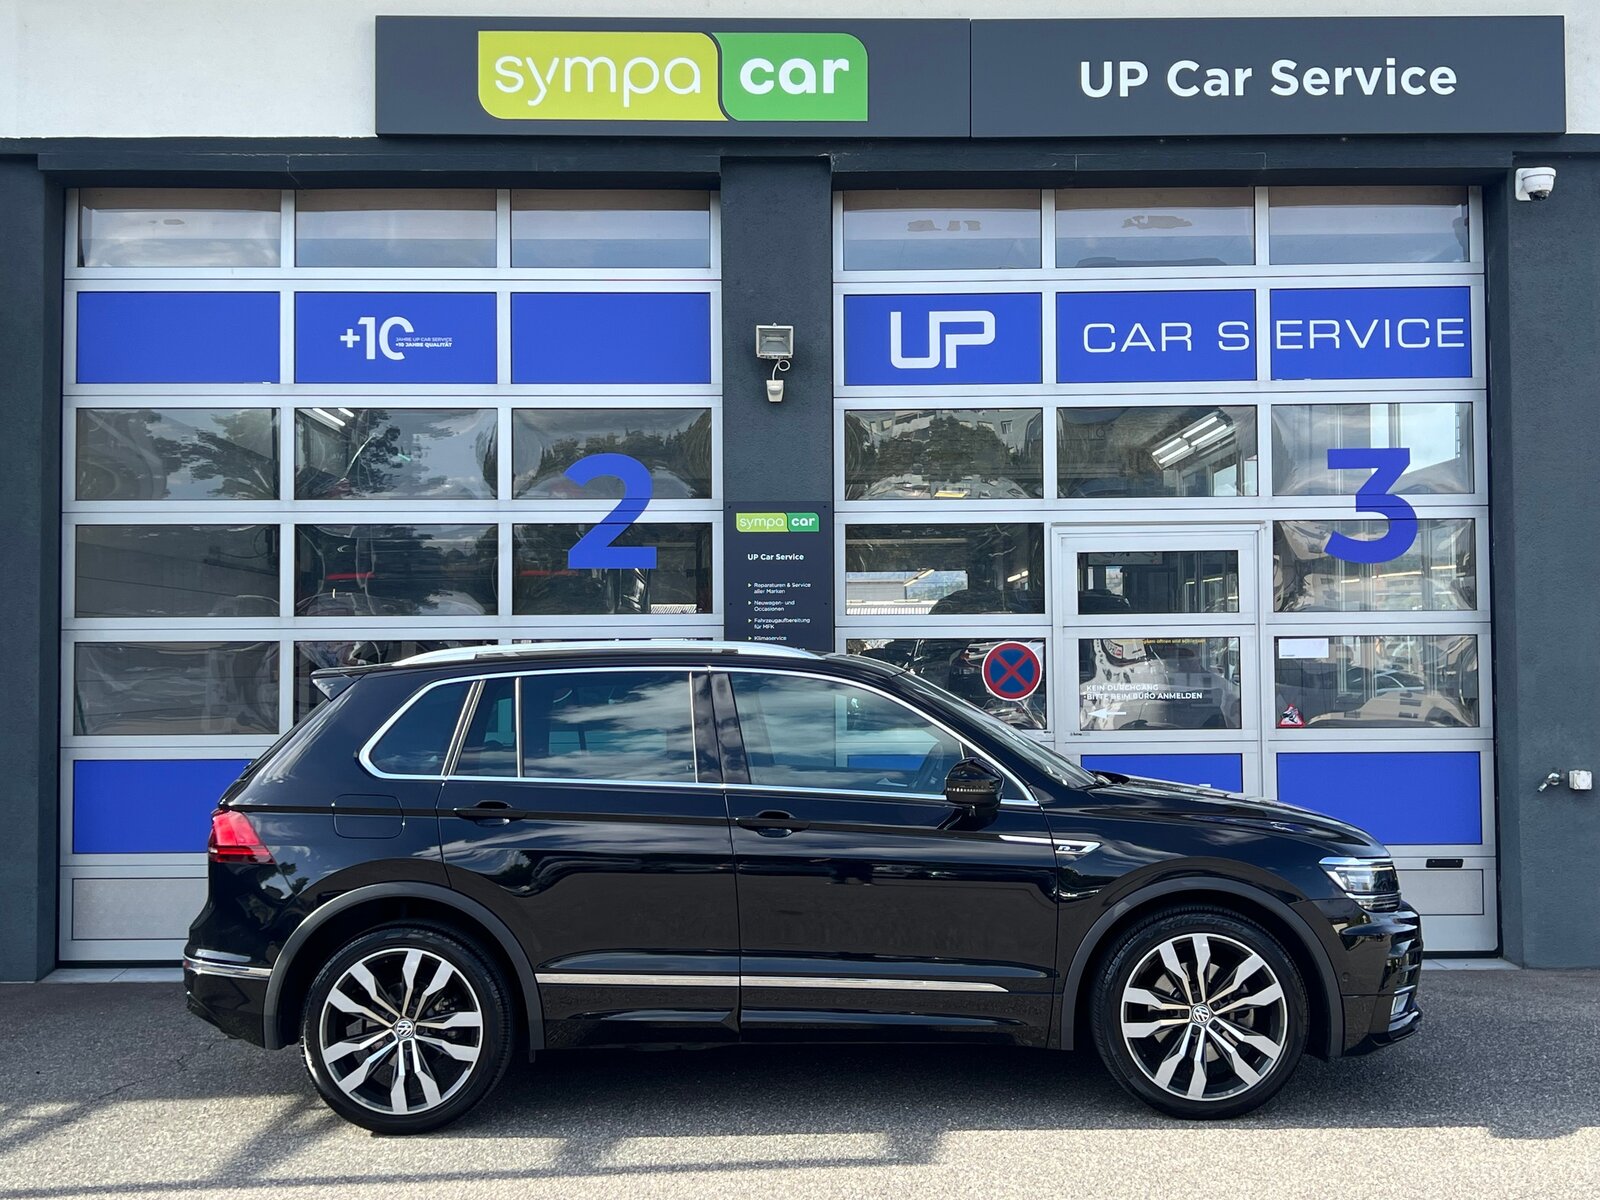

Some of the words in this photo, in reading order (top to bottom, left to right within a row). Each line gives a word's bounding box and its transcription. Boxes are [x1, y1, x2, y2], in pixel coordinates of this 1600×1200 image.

[494, 55, 701, 107] sympa
[739, 57, 850, 95] car
[1080, 60, 1149, 98] UP
[1166, 59, 1253, 97] Car
[1270, 57, 1457, 96] Service
[890, 310, 995, 369] UP
[1082, 322, 1193, 354] CAR
[564, 453, 658, 569] 2
[739, 517, 785, 529] sympa
[791, 517, 816, 527] car
[1324, 447, 1418, 564] 3
[747, 553, 759, 561] UP
[760, 553, 774, 561] Car
[775, 553, 804, 561] Service
[1086, 683, 1105, 692] KEIN
[1107, 683, 1159, 692] DURCHGANG
[1111, 691, 1133, 700] BEIM
[1133, 690, 1155, 700] BÜRO
[1157, 691, 1203, 700] ANMELDEN
